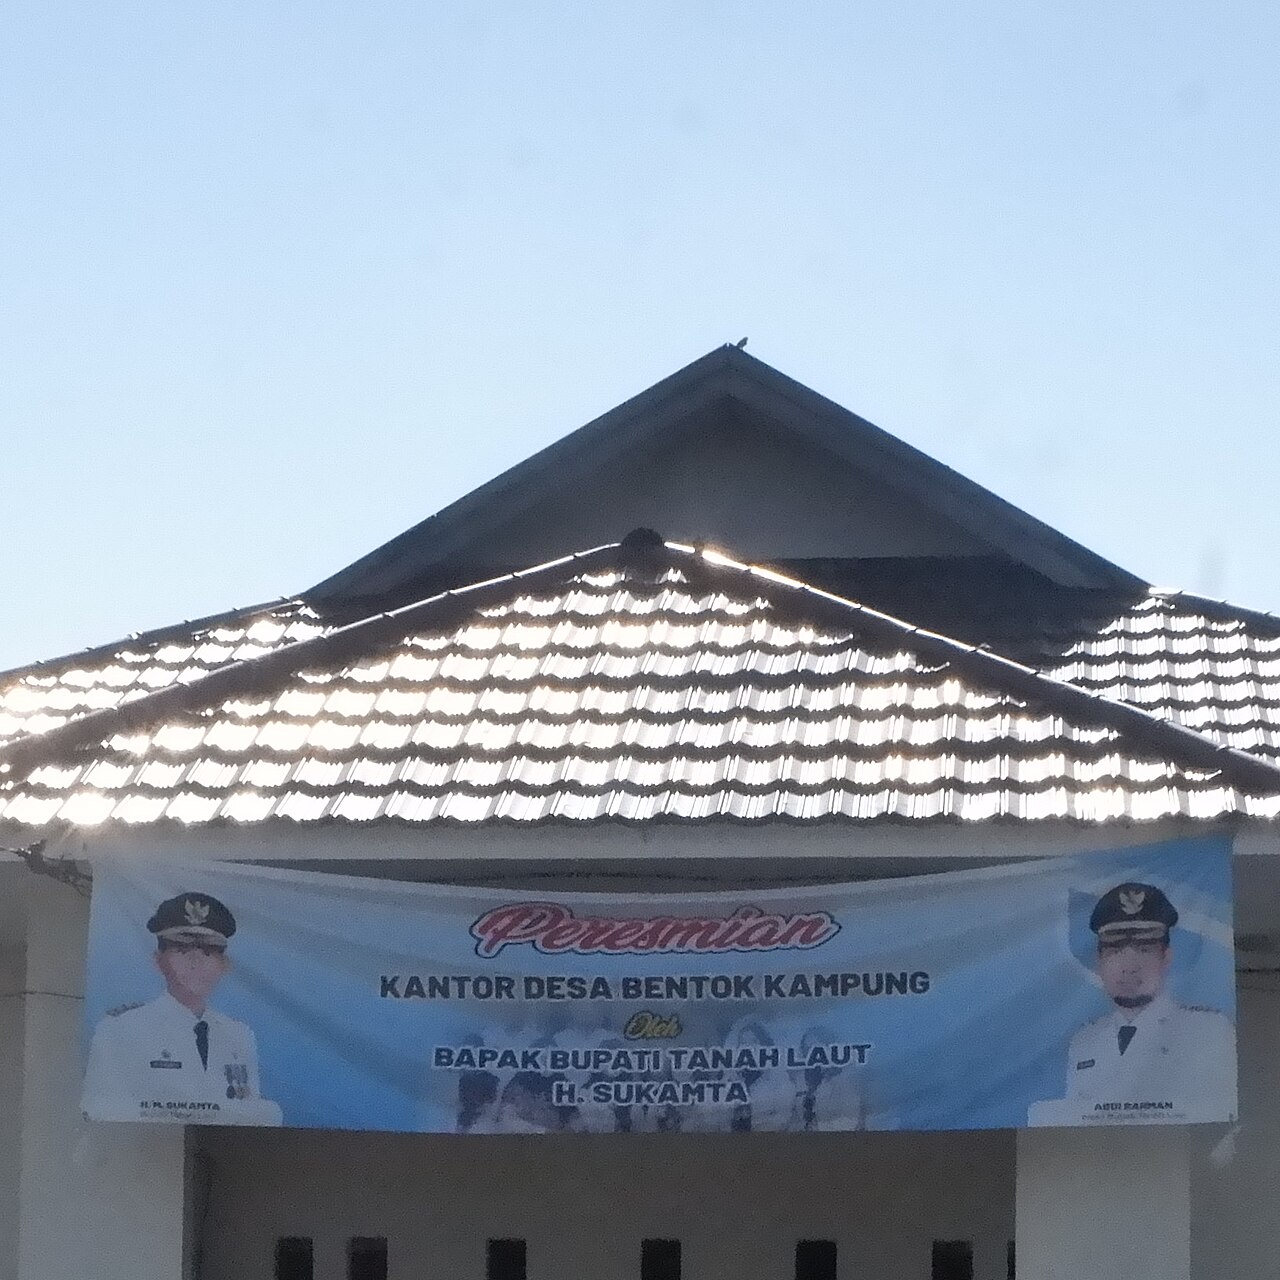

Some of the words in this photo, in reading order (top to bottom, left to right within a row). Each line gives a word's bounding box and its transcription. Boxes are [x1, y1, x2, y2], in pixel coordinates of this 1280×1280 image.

[472, 902, 840, 957] Peresmian
[380, 975, 515, 1001] KANTOR
[524, 975, 613, 1001] DESA
[622, 974, 756, 1000] BENTOK
[764, 971, 931, 998] KAMPUNG
[624, 1011, 683, 1041] Oleh
[434, 1046, 543, 1070] BAPAK
[550, 1048, 661, 1073] BUPATI
[671, 1046, 779, 1071] TANAH
[787, 1045, 871, 1069] LAUT
[553, 1082, 584, 1106] H.
[594, 1082, 749, 1106] SUKAMTA
